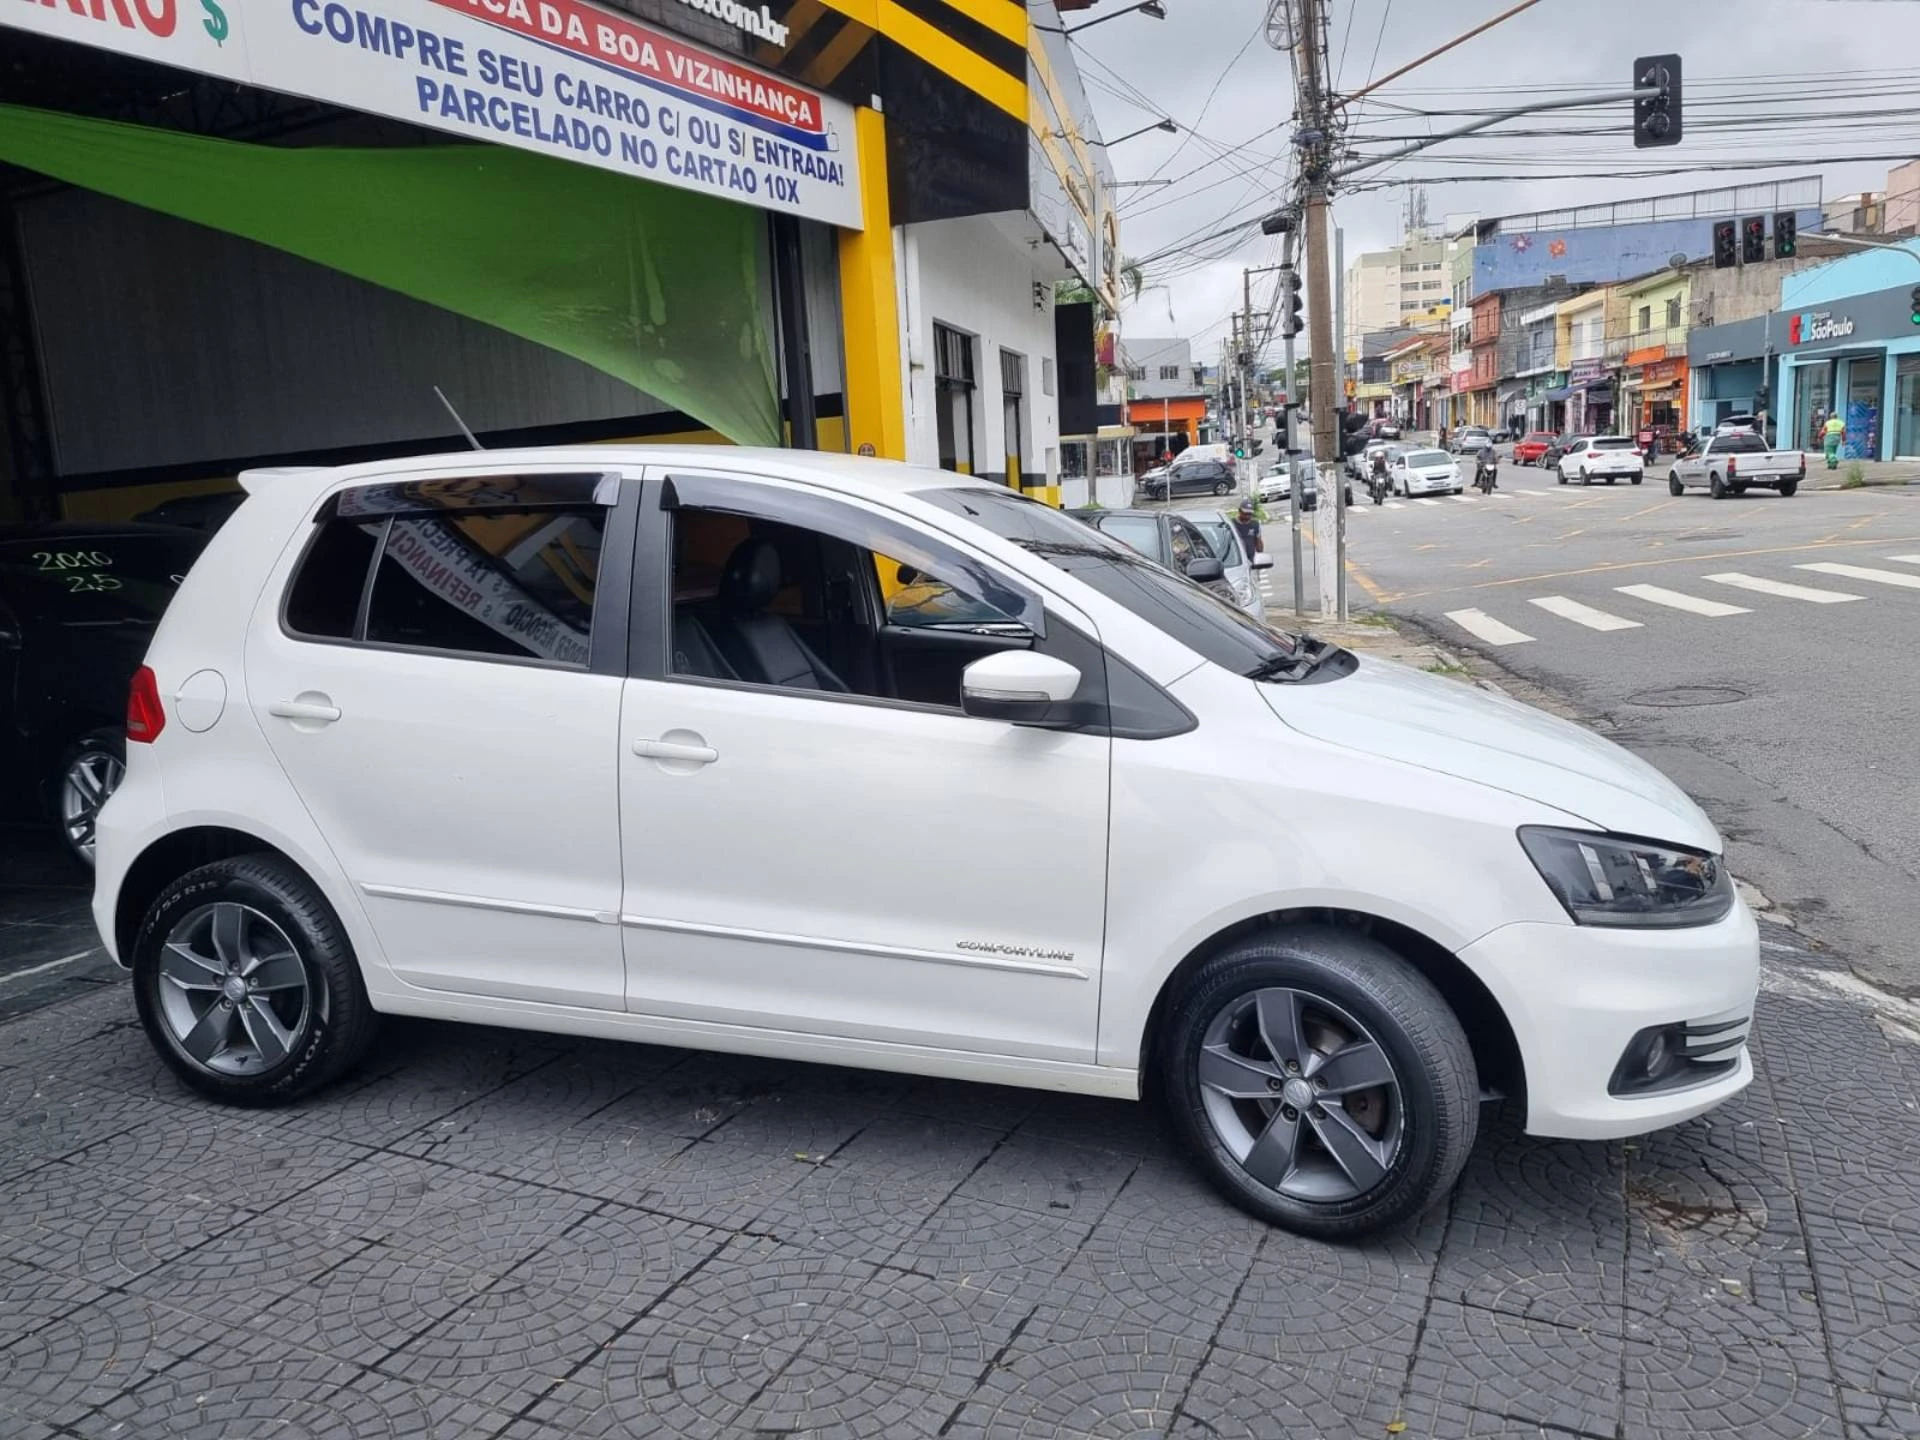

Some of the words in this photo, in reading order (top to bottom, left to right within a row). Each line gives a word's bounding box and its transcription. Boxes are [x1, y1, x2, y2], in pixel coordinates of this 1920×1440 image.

[292, 0, 468, 77] COMPRE
[477, 48, 544, 98] SEU
[554, 73, 650, 129] CARRO
[658, 106, 680, 139] C/
[688, 116, 720, 150] OU
[728, 128, 746, 157] S/
[753, 137, 845, 186] ENTRADA!
[540, 2, 589, 46] DA
[597, 24, 661, 72] BOA
[665, 50, 813, 125] VIZINHANÇA
[415, 76, 612, 157] PARCELADO
[620, 131, 657, 169] NO
[765, 173, 800, 205] 10X
[956, 941, 1075, 961] COMFORTLINE
